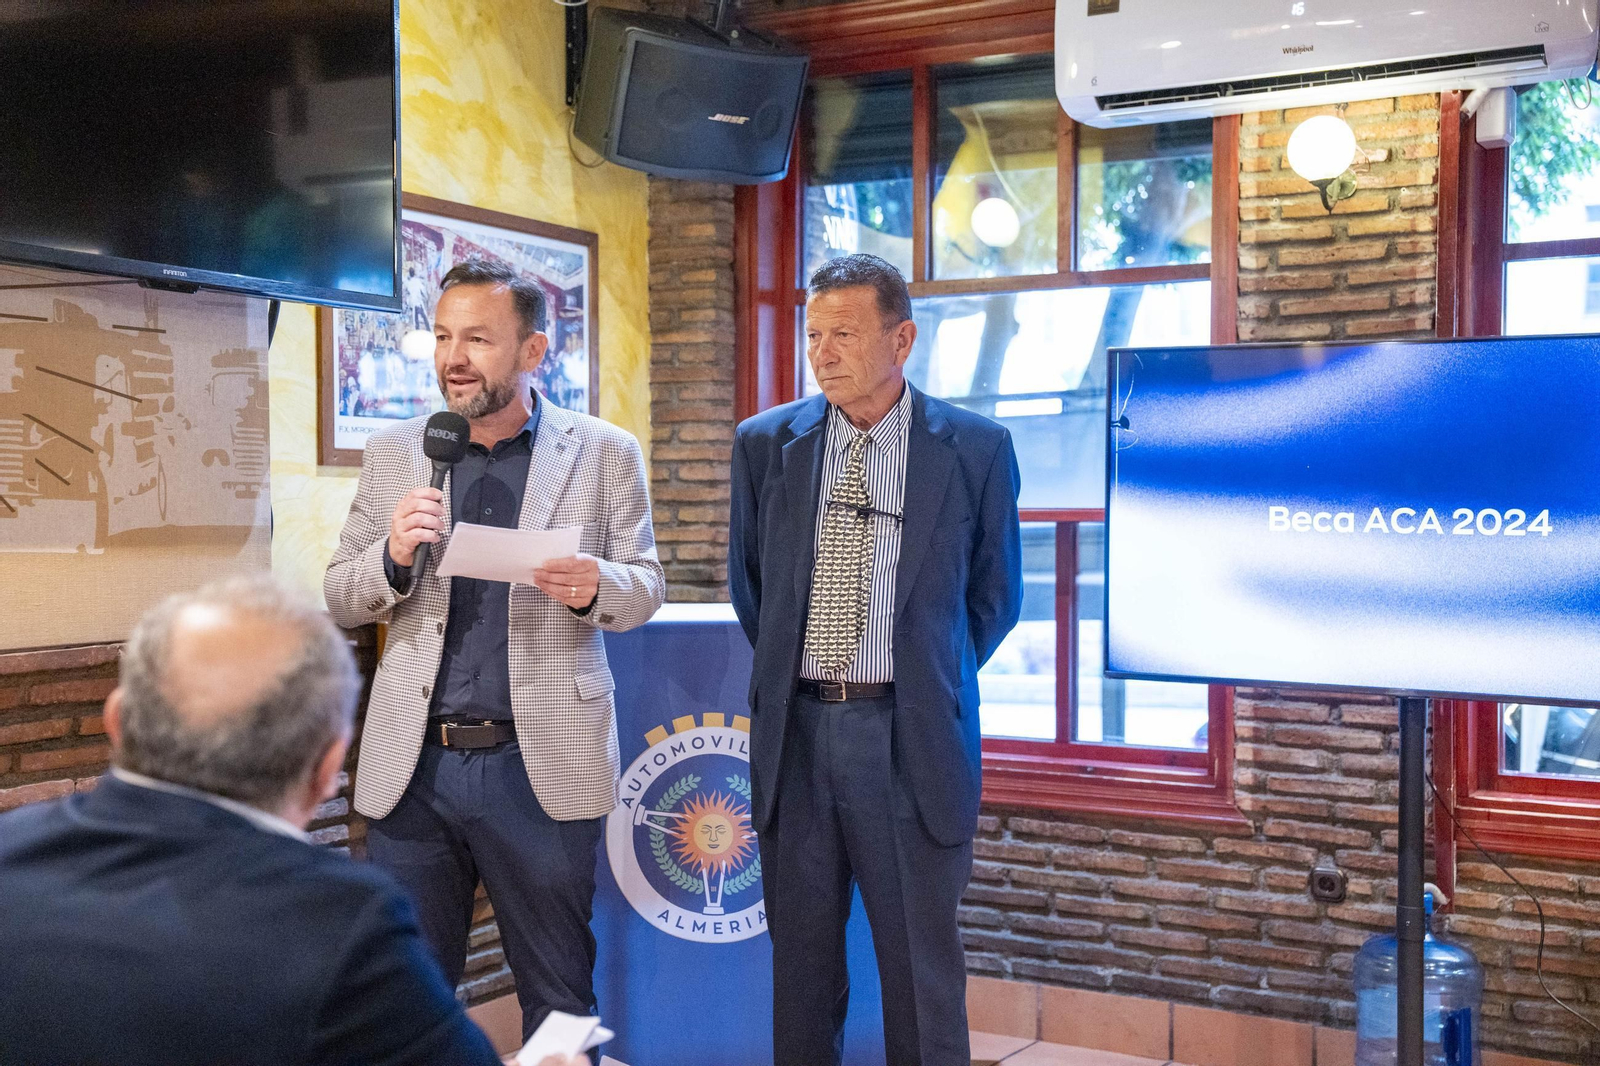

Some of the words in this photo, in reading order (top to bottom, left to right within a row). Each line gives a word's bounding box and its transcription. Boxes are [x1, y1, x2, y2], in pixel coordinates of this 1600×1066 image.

[1282, 44, 1314, 55] Whirlpool
[708, 113, 749, 124] BOSE
[427, 427, 459, 442] RØDE
[1268, 506, 1355, 533] Beca
[1363, 507, 1444, 535] ACA
[1452, 508, 1553, 537] 2024
[621, 735, 748, 809] AUTOMOVIL
[657, 909, 767, 935] ALMERIA
